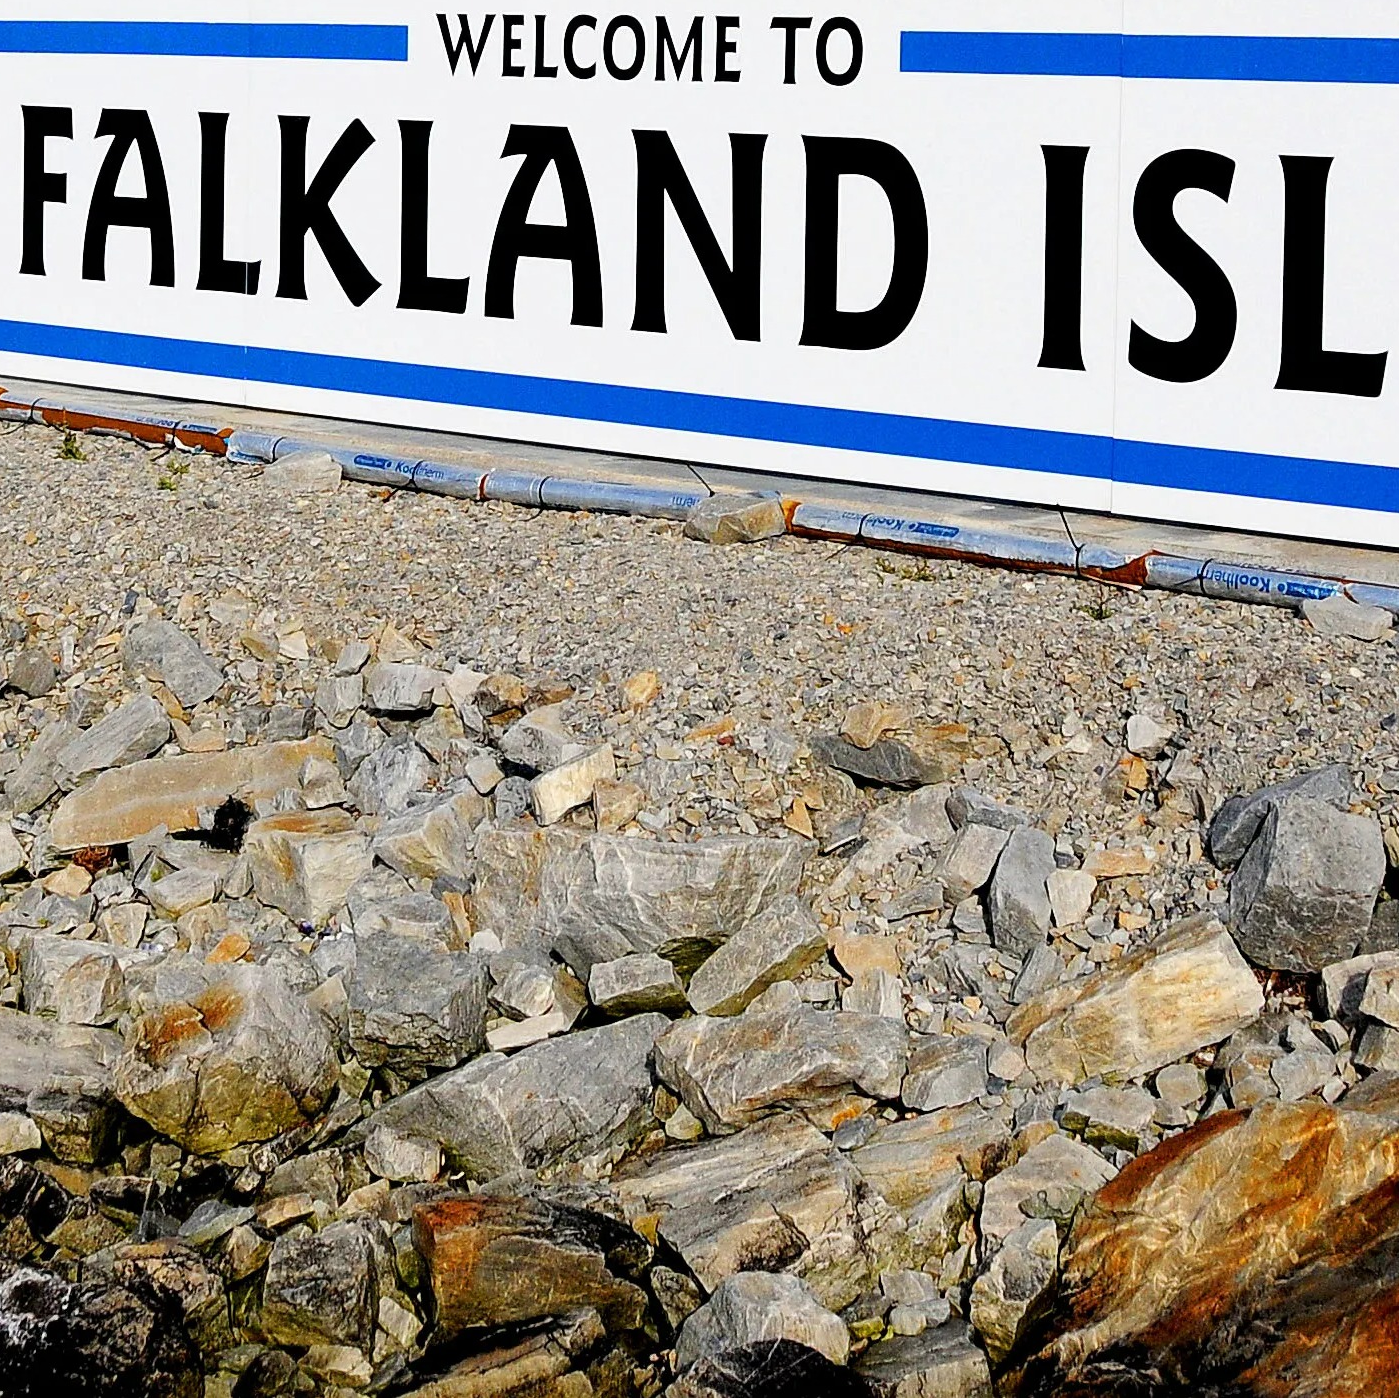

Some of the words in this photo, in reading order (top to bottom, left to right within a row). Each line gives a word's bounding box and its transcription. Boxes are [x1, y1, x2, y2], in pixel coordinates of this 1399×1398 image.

[435, 13, 743, 83] WELCOME
[769, 16, 865, 87] TO
[18, 104, 930, 352] FALKLAND
